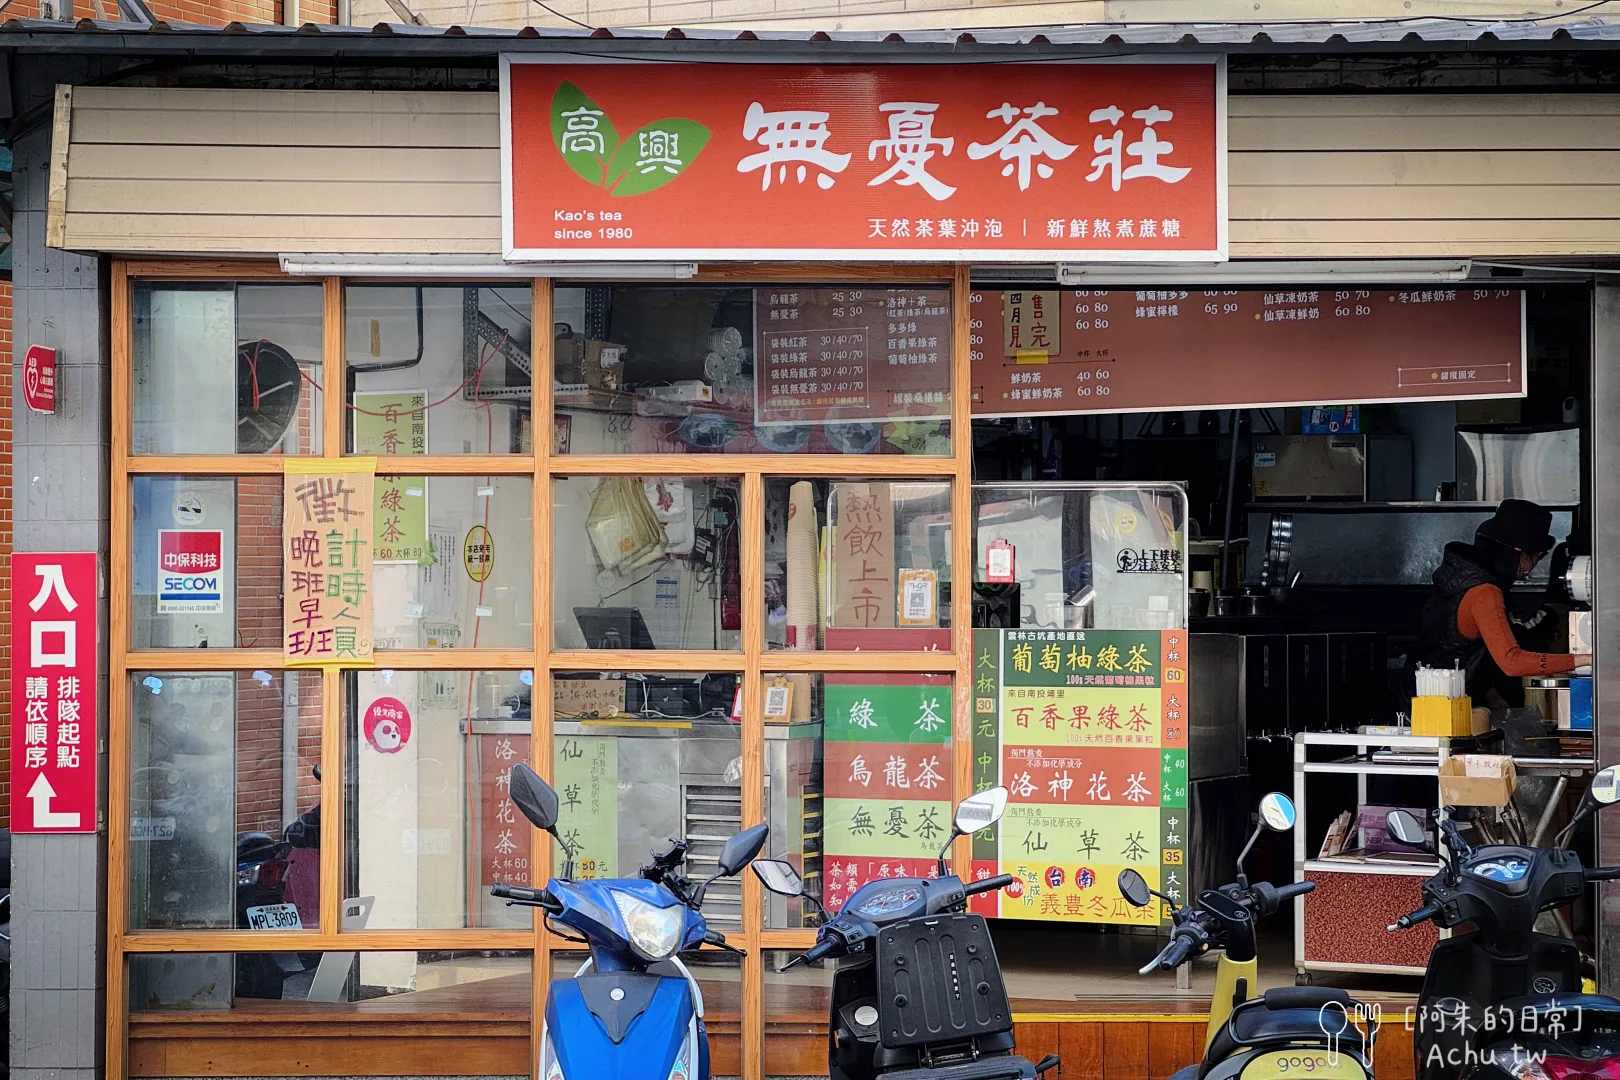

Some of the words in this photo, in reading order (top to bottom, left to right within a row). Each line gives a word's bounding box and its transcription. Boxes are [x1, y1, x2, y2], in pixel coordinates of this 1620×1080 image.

[559, 106, 683, 176] 高興
[736, 101, 1193, 200] 無憂茶莊
[554, 210, 595, 221] Kao's
[599, 210, 622, 221] tea
[554, 229, 593, 239] since
[598, 228, 633, 239] 1980
[867, 218, 1004, 239] 天然茶葉沖泡
[1046, 218, 1181, 239] 新鮮熬煮蔗糖
[832, 293, 844, 302] 25
[850, 291, 862, 300] 30
[1335, 291, 1349, 301] 50
[1355, 290, 1370, 301] 70
[1398, 290, 1457, 304] 冬瓜鮮奶茶
[832, 308, 844, 317] 25
[850, 307, 862, 316] 30
[1076, 304, 1089, 313] 60
[1094, 303, 1108, 313] 80
[1204, 303, 1218, 315] 65
[1223, 304, 1238, 315] 90
[1335, 306, 1350, 317] 60
[1355, 305, 1371, 316] 80
[969, 319, 982, 329] 60
[1030, 294, 1051, 348] 售完
[1076, 320, 1090, 330] 60
[1094, 319, 1109, 329] 80
[969, 334, 983, 345] 80
[969, 350, 984, 361] 80
[1077, 371, 1091, 382] 40
[1096, 369, 1109, 379] 60
[1077, 386, 1091, 396] 60
[1096, 385, 1110, 396] 80
[411, 396, 424, 453] 來自南投
[164, 553, 217, 567] 中保科技
[380, 549, 392, 559] 60
[843, 490, 888, 628] 熱飲上市
[164, 577, 217, 590] SECOM
[288, 530, 333, 655] 晚班早班
[325, 528, 367, 658] 計時人員
[28, 564, 78, 668] 入口
[1007, 631, 1086, 641] 雲林古坑產地直送
[1012, 642, 1153, 674] 葡萄柚綠茶
[1167, 636, 1181, 662] 中杯
[1167, 670, 1181, 681] 60
[849, 697, 946, 732] 綠茶
[1167, 694, 1181, 720] 大杯
[25, 677, 48, 769] 請依順序
[57, 676, 80, 768] 排隊起點
[1011, 703, 1153, 732] 百香果綠茶
[848, 754, 946, 789] 烏龍茶
[1174, 759, 1184, 768] 40
[495, 738, 517, 854] 洛神花茶
[1010, 771, 1152, 803] 洛神花茶
[1174, 787, 1185, 797] 60
[560, 739, 585, 856] 仙草茶
[847, 805, 946, 839] 無憂茶
[1166, 817, 1181, 844] 中杯
[1022, 829, 1151, 861] 仙草茶
[1165, 852, 1180, 862] 35
[1048, 868, 1094, 887] 台南
[1167, 870, 1181, 900] 大杯
[1166, 906, 1182, 917] 5
[251, 912, 298, 930] MPL-3809
